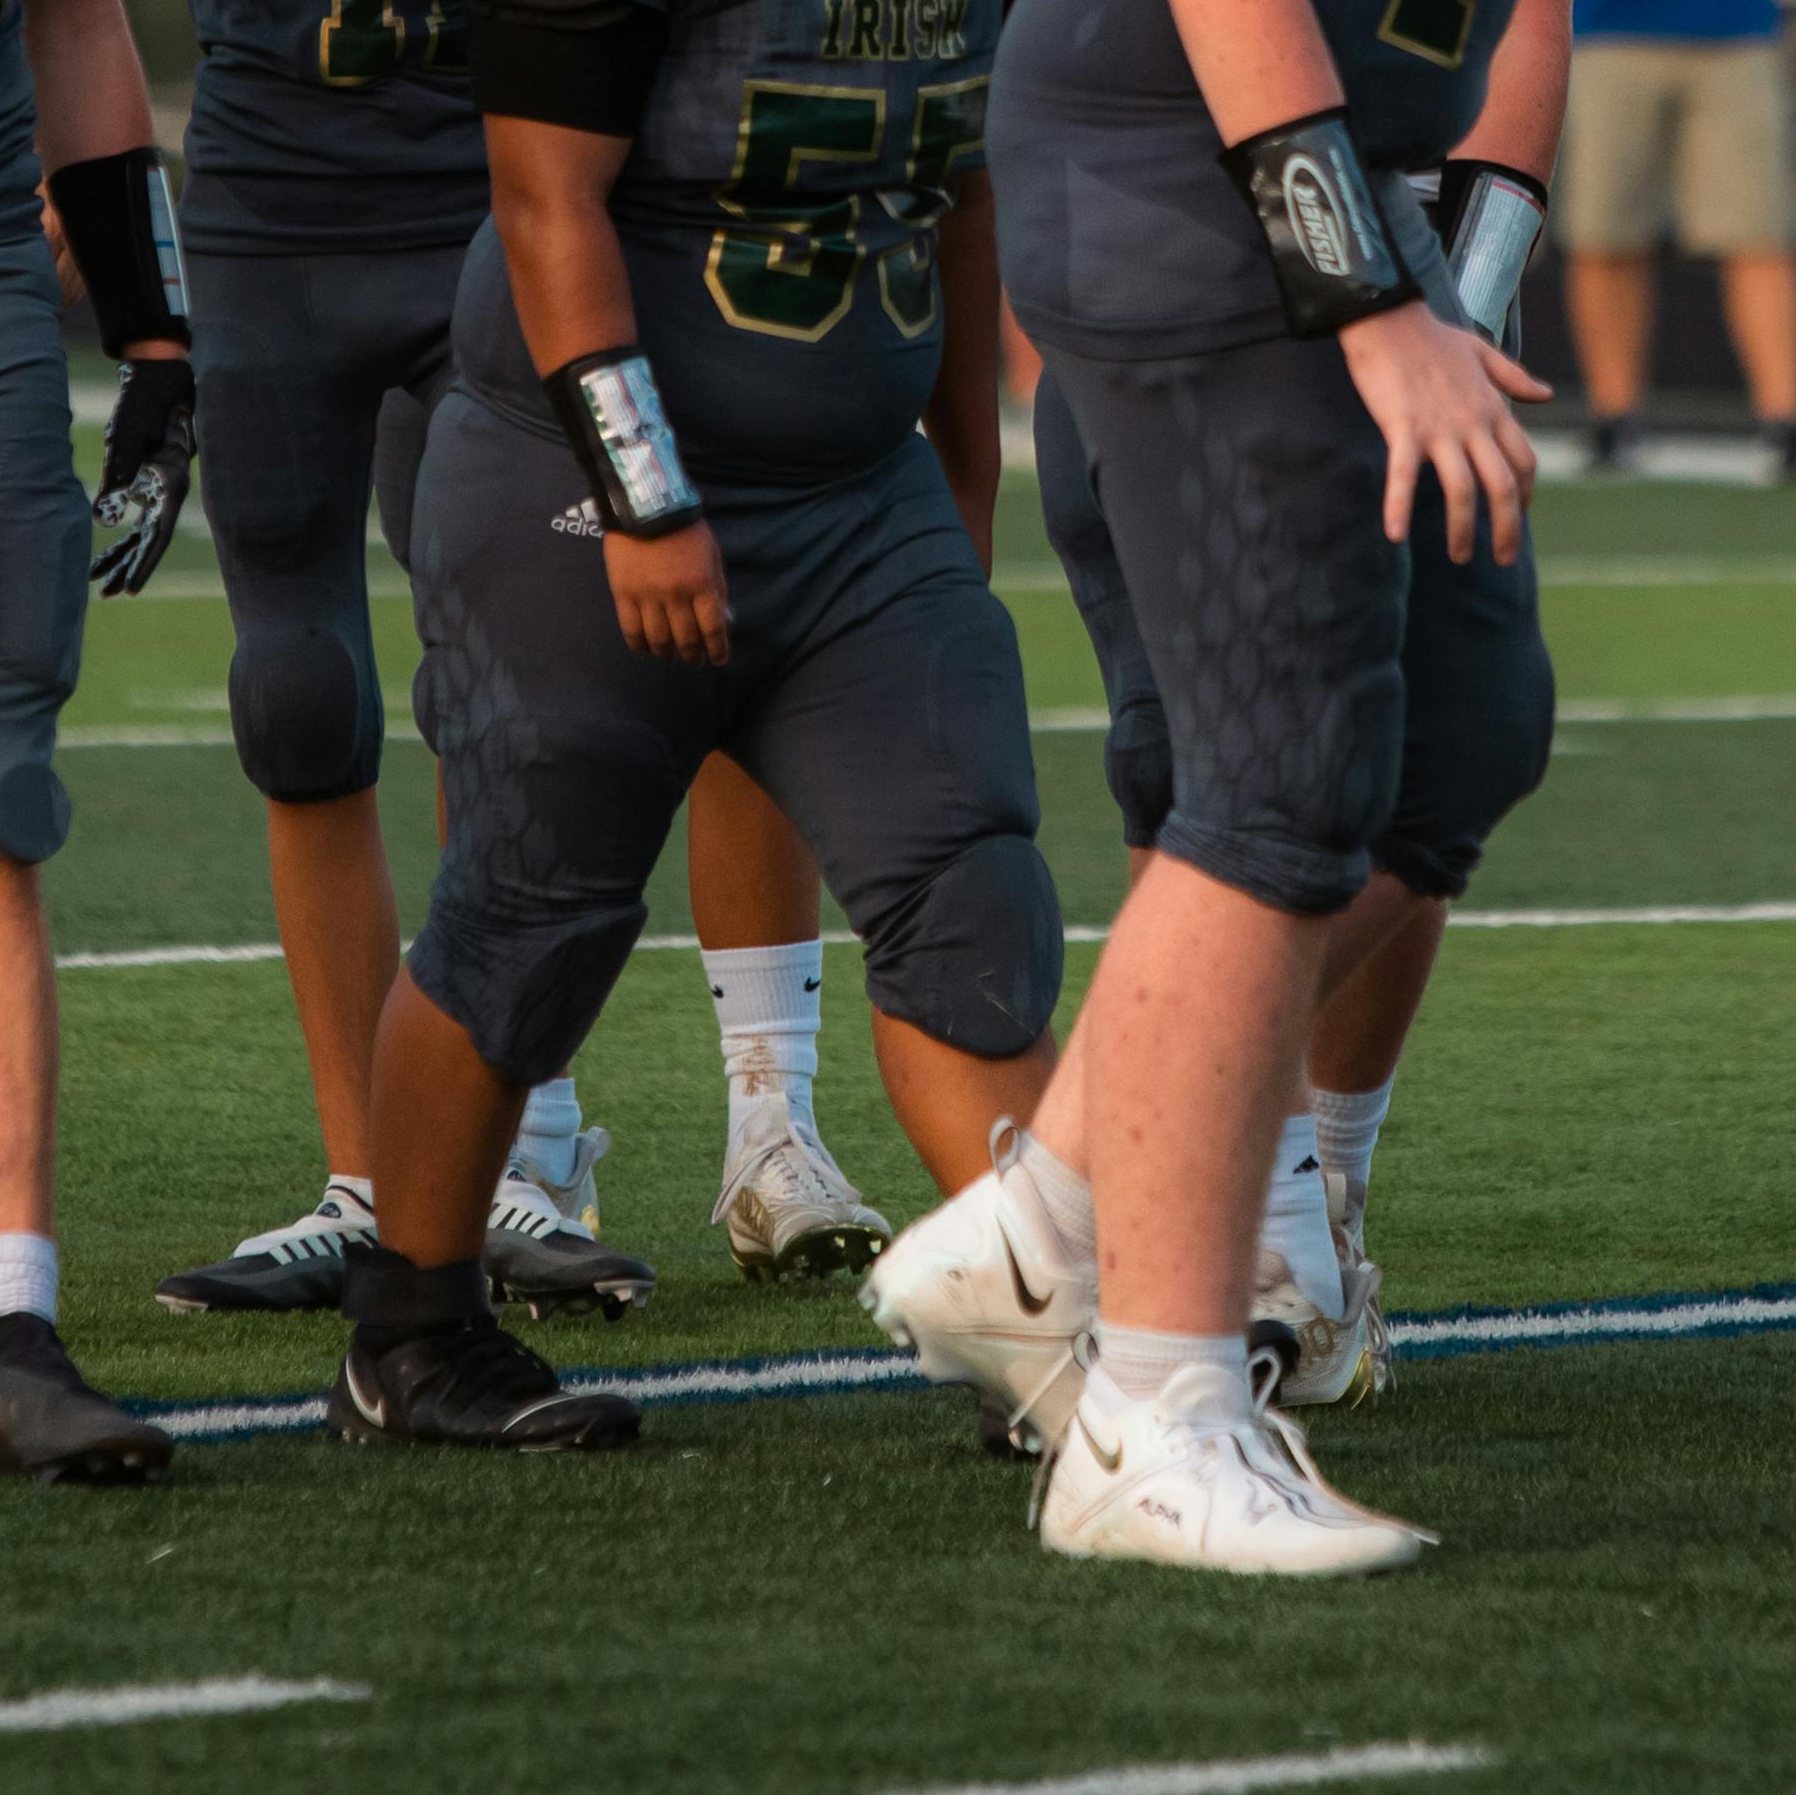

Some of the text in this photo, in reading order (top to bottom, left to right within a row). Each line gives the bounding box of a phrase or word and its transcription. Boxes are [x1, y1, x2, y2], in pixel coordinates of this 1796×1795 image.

[703, 75, 991, 344] 55
[1293, 187, 1345, 278] FISHER
[550, 515, 605, 540] adi
